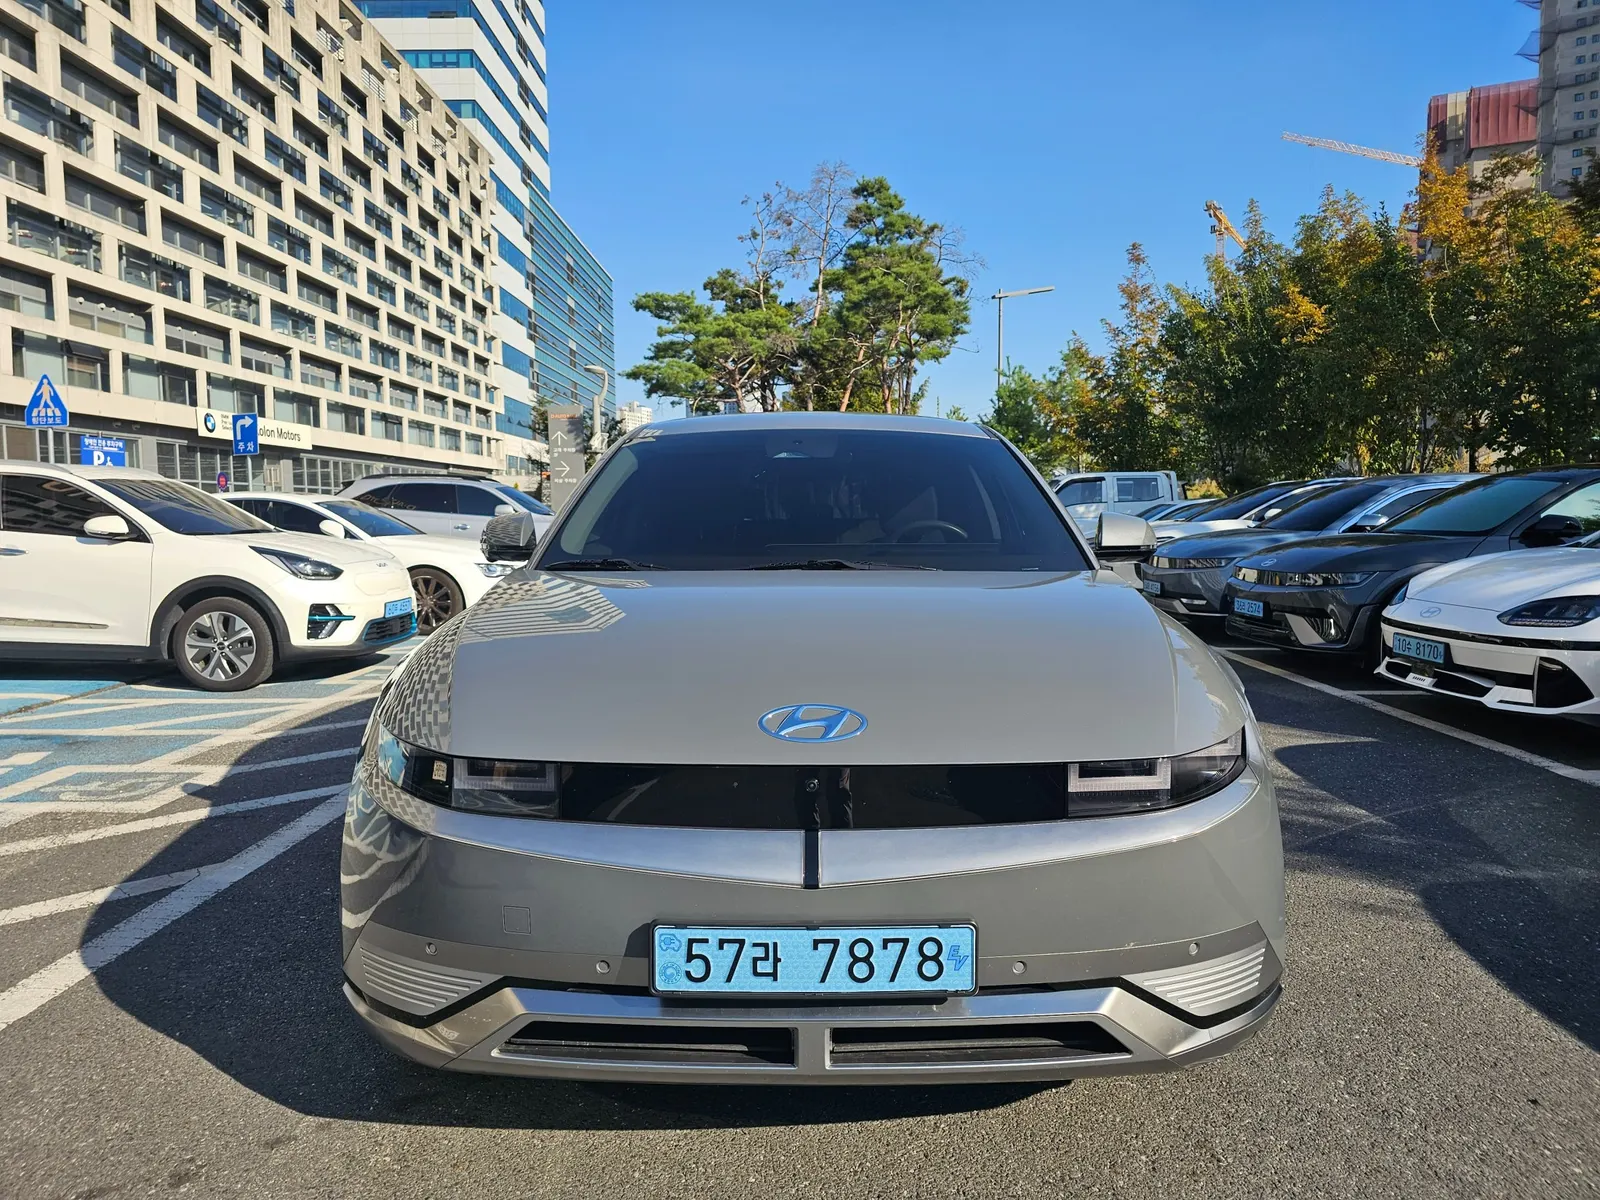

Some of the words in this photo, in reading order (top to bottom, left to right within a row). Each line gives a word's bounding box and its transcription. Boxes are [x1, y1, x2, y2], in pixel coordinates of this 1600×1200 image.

[258, 425, 275, 438] olon
[277, 427, 301, 442] Motors
[238, 441, 254, 452] 주차
[93, 450, 105, 466] P
[1398, 637, 1412, 653] 10수
[1415, 641, 1439, 660] 8170
[684, 937, 782, 983] 57라
[812, 936, 945, 984] 7878
[947, 944, 969, 971] EV
